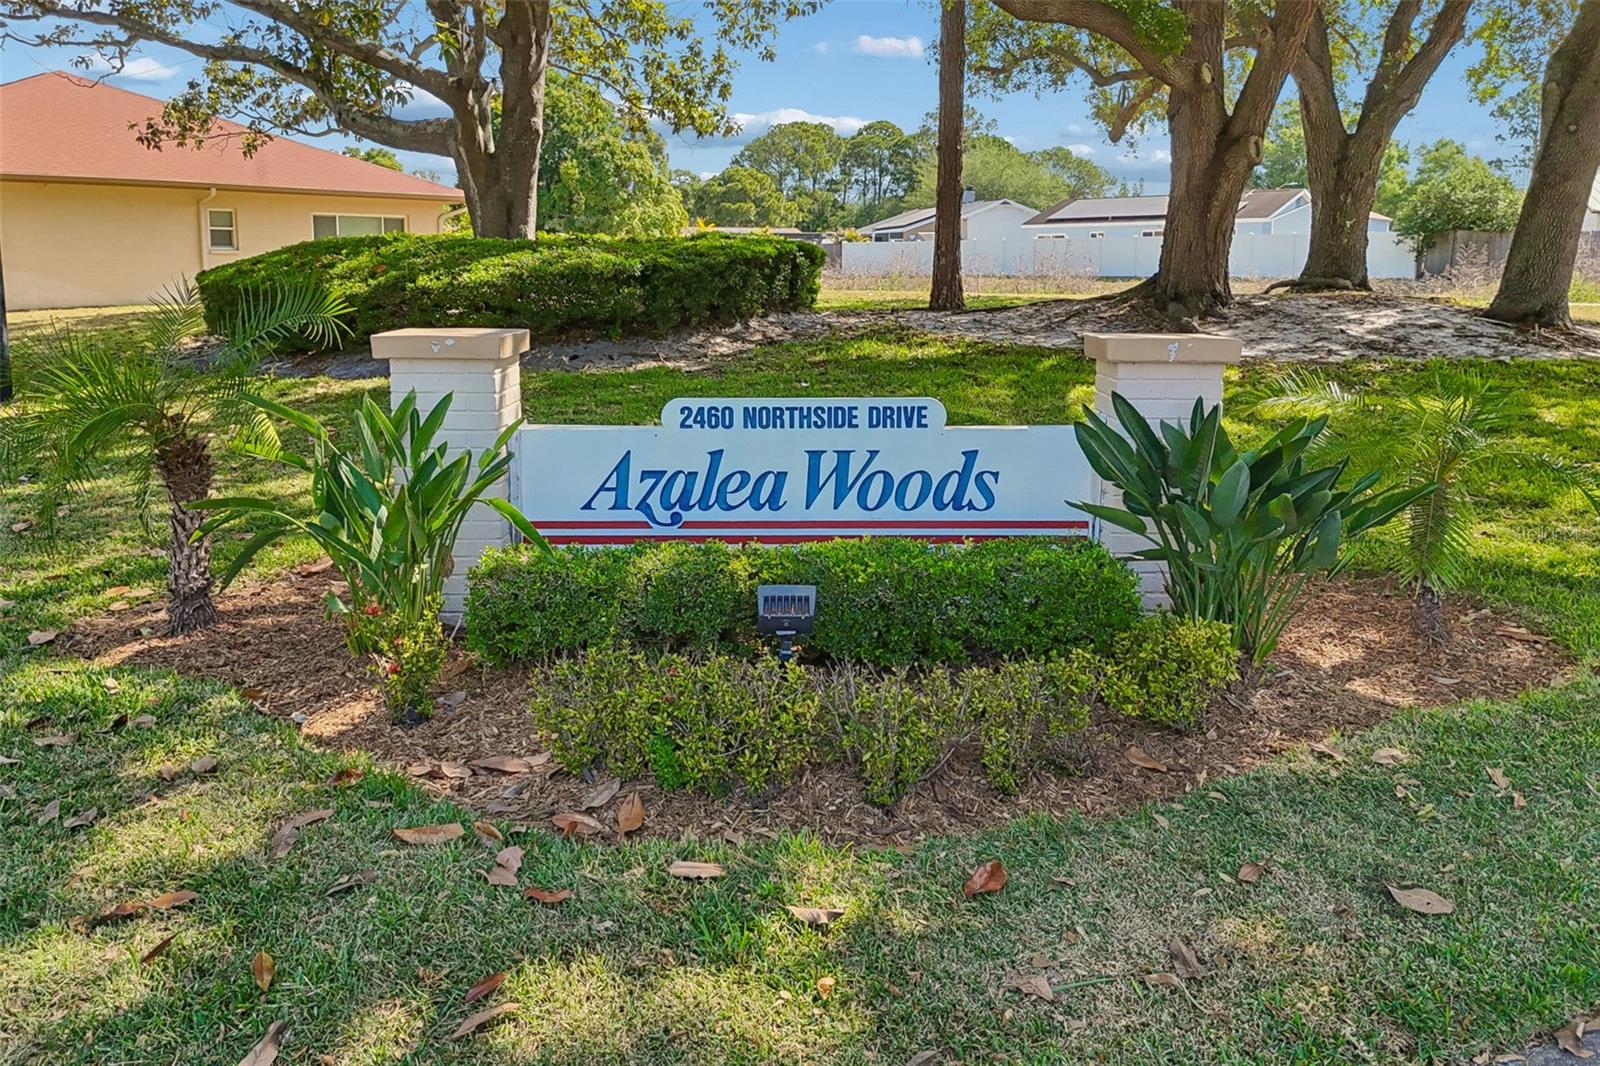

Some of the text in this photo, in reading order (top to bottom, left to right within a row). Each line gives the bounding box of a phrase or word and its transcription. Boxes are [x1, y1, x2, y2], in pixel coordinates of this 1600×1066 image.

[679, 405, 929, 430] 2460 NORTHSIDE DRIVE
[580, 448, 1000, 528] Azalea Woods
